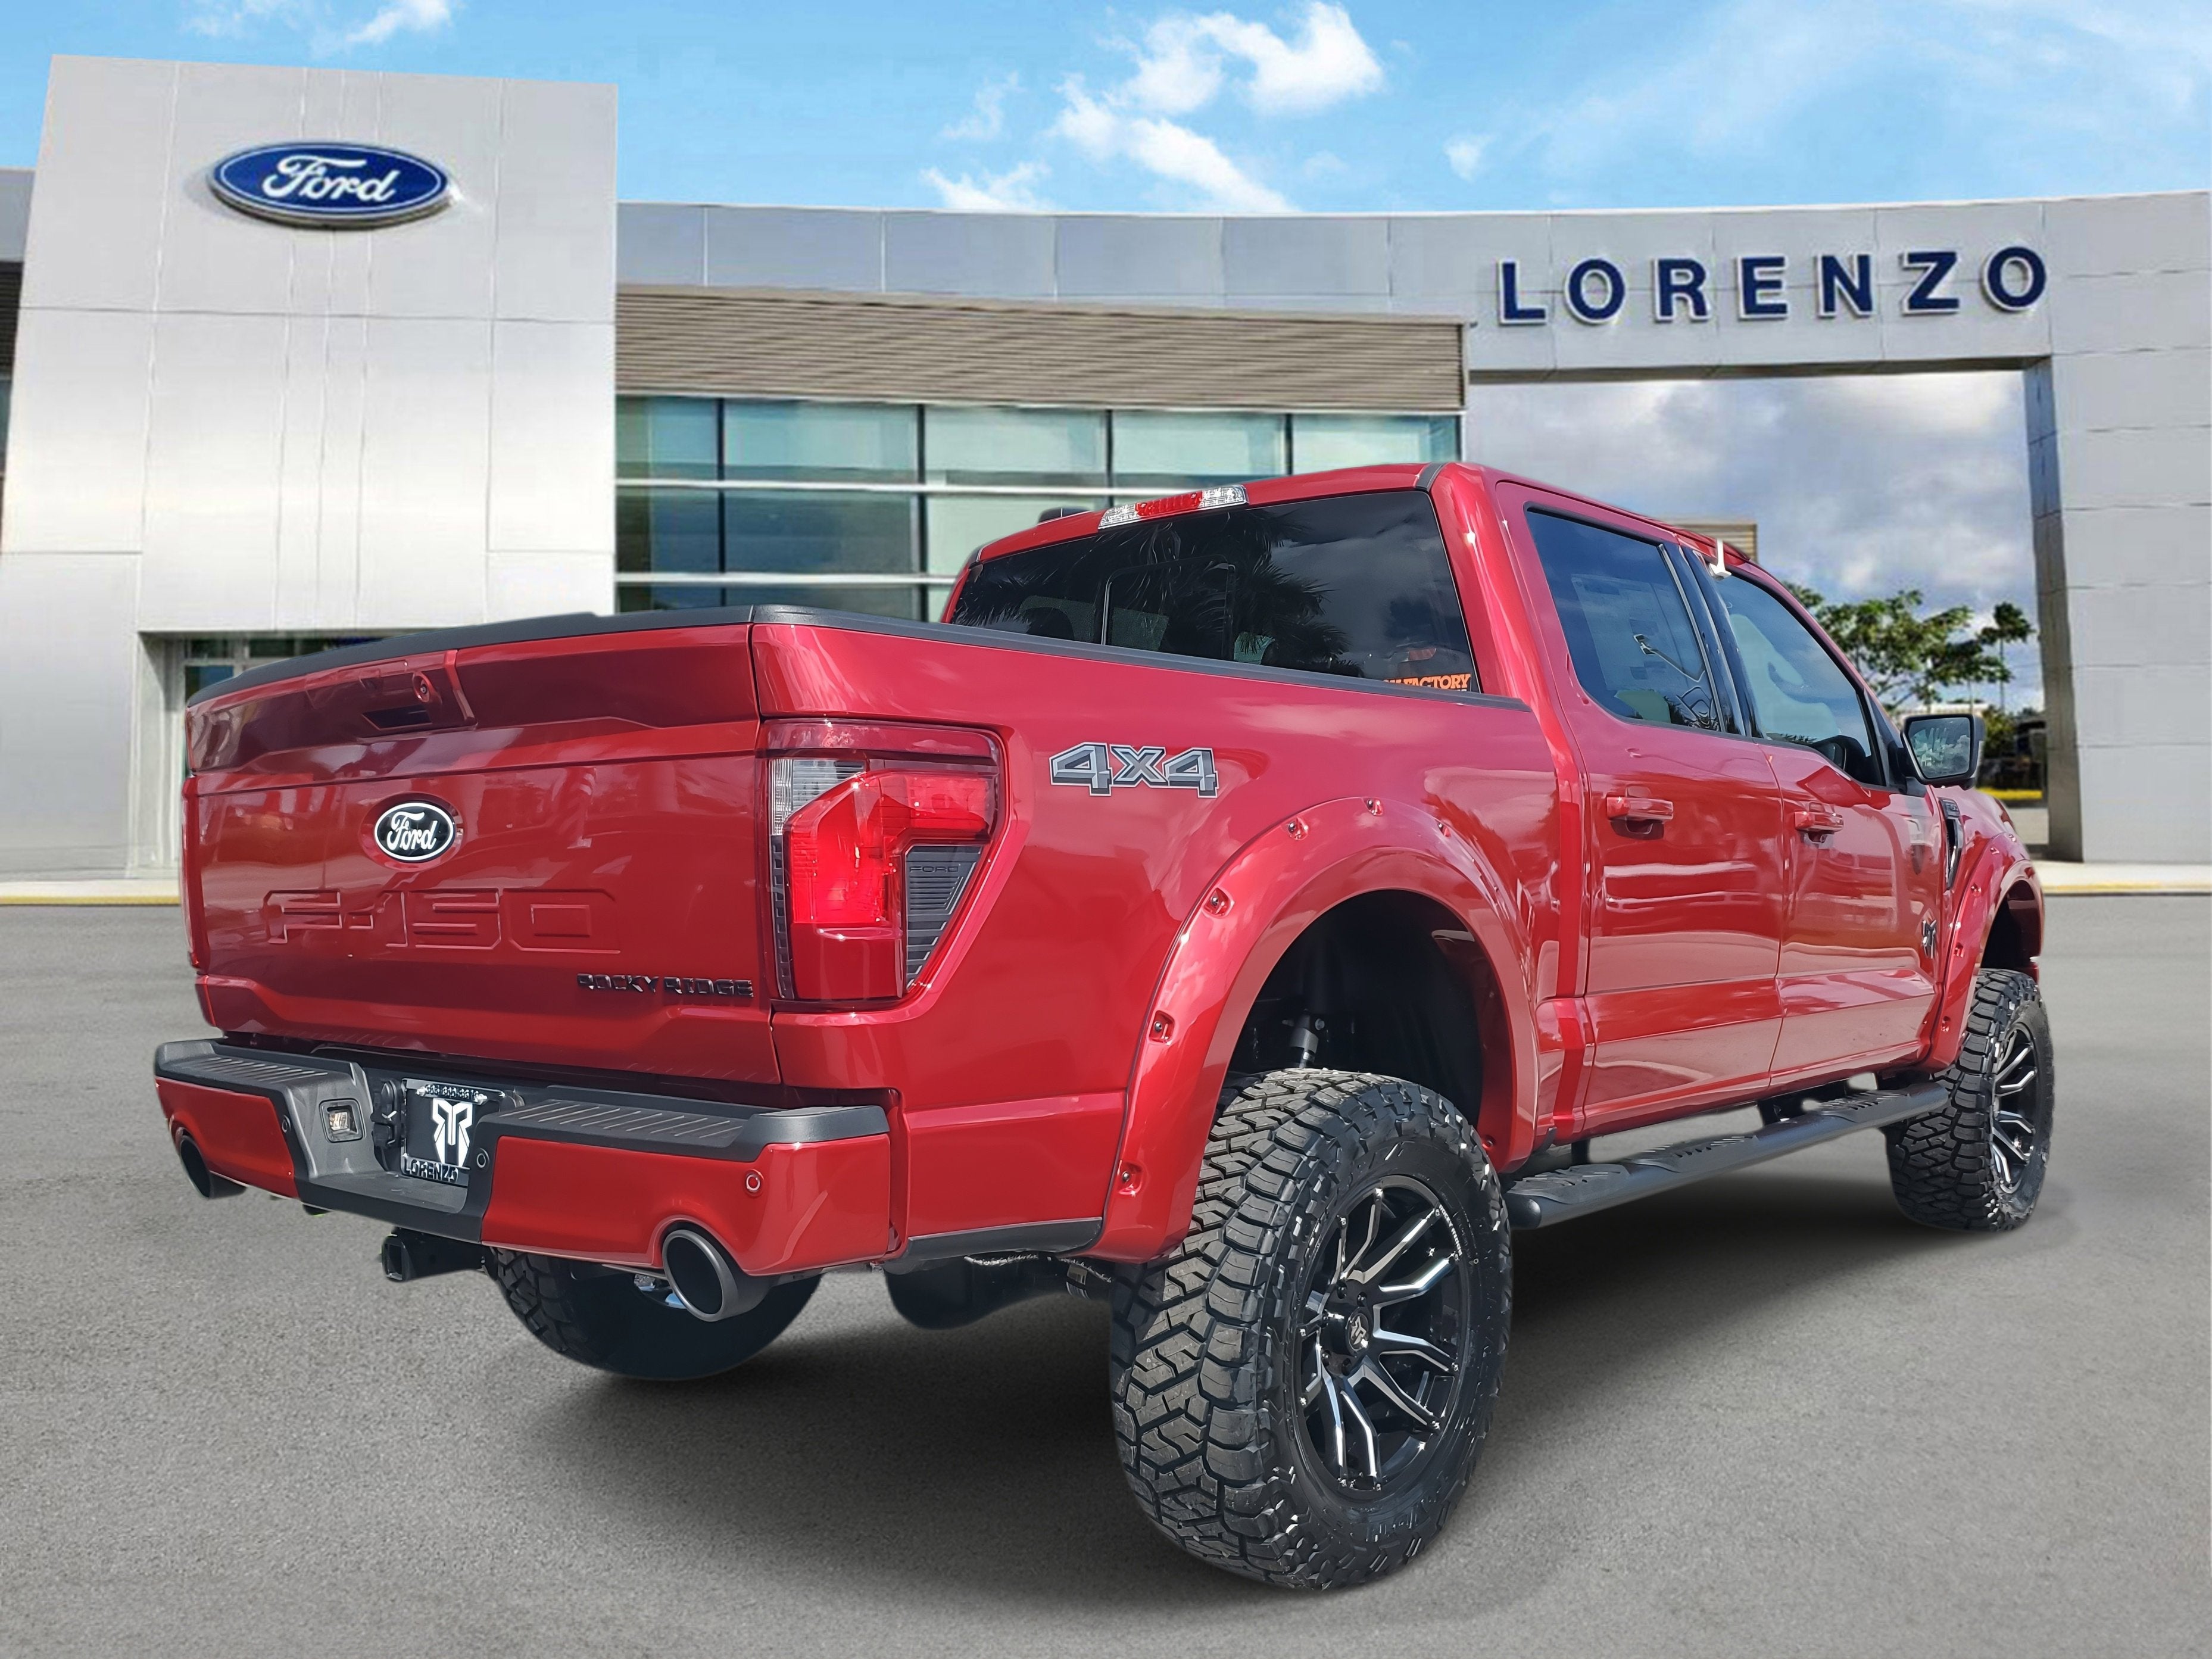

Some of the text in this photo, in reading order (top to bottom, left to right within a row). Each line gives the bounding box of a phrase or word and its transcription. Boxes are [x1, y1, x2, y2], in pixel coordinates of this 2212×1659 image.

[262, 155, 400, 201] Ford
[1497, 247, 2047, 325] LORENZO
[387, 811, 438, 850] Ford
[263, 888, 620, 954] F-150
[577, 974, 754, 997] ROCKY RIDGE
[404, 1158, 458, 1183] LORENZO
